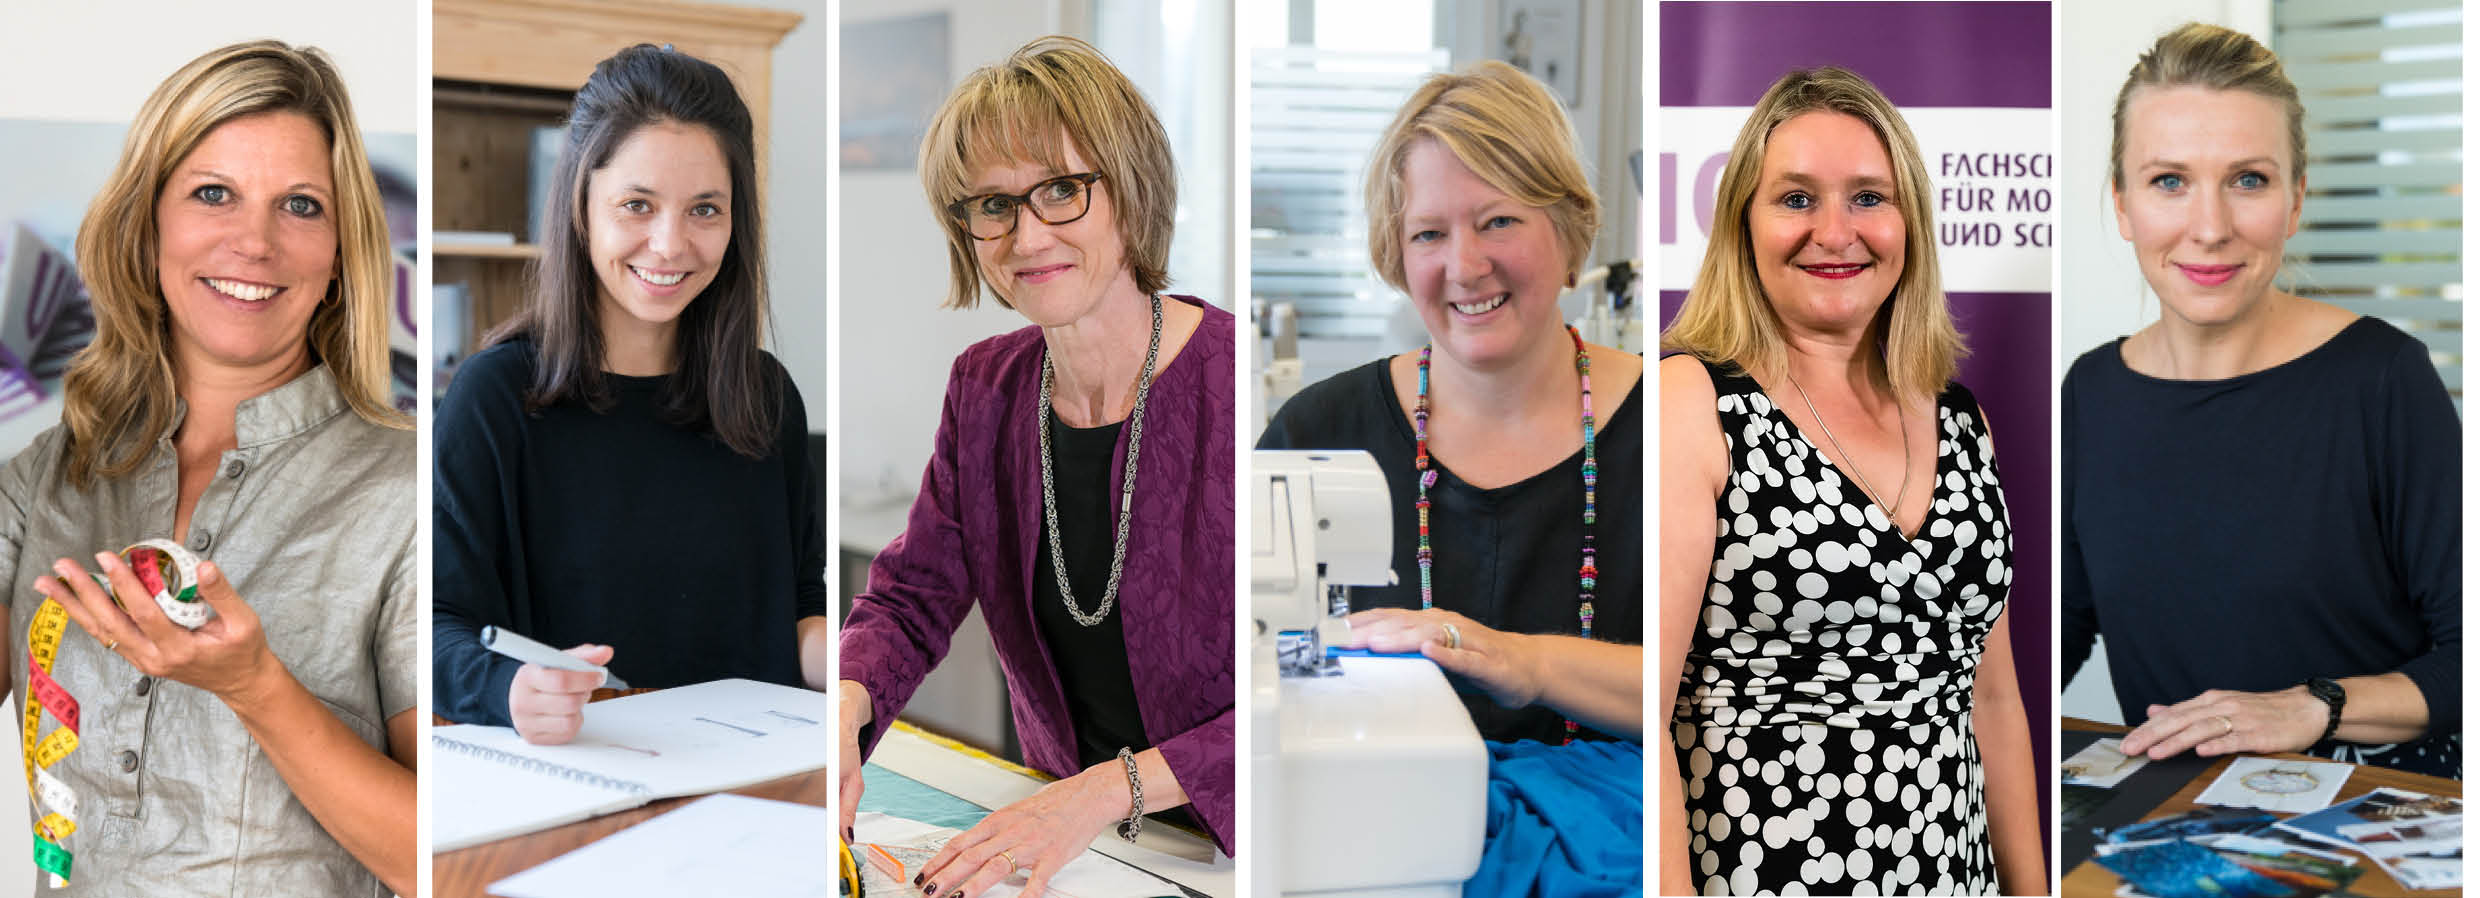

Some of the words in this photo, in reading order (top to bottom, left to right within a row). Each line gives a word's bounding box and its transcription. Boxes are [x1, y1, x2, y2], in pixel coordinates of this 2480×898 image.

[1941, 181, 1995, 212] FÜR
[2007, 188, 2052, 212] MO
[1941, 222, 2002, 247] UND
